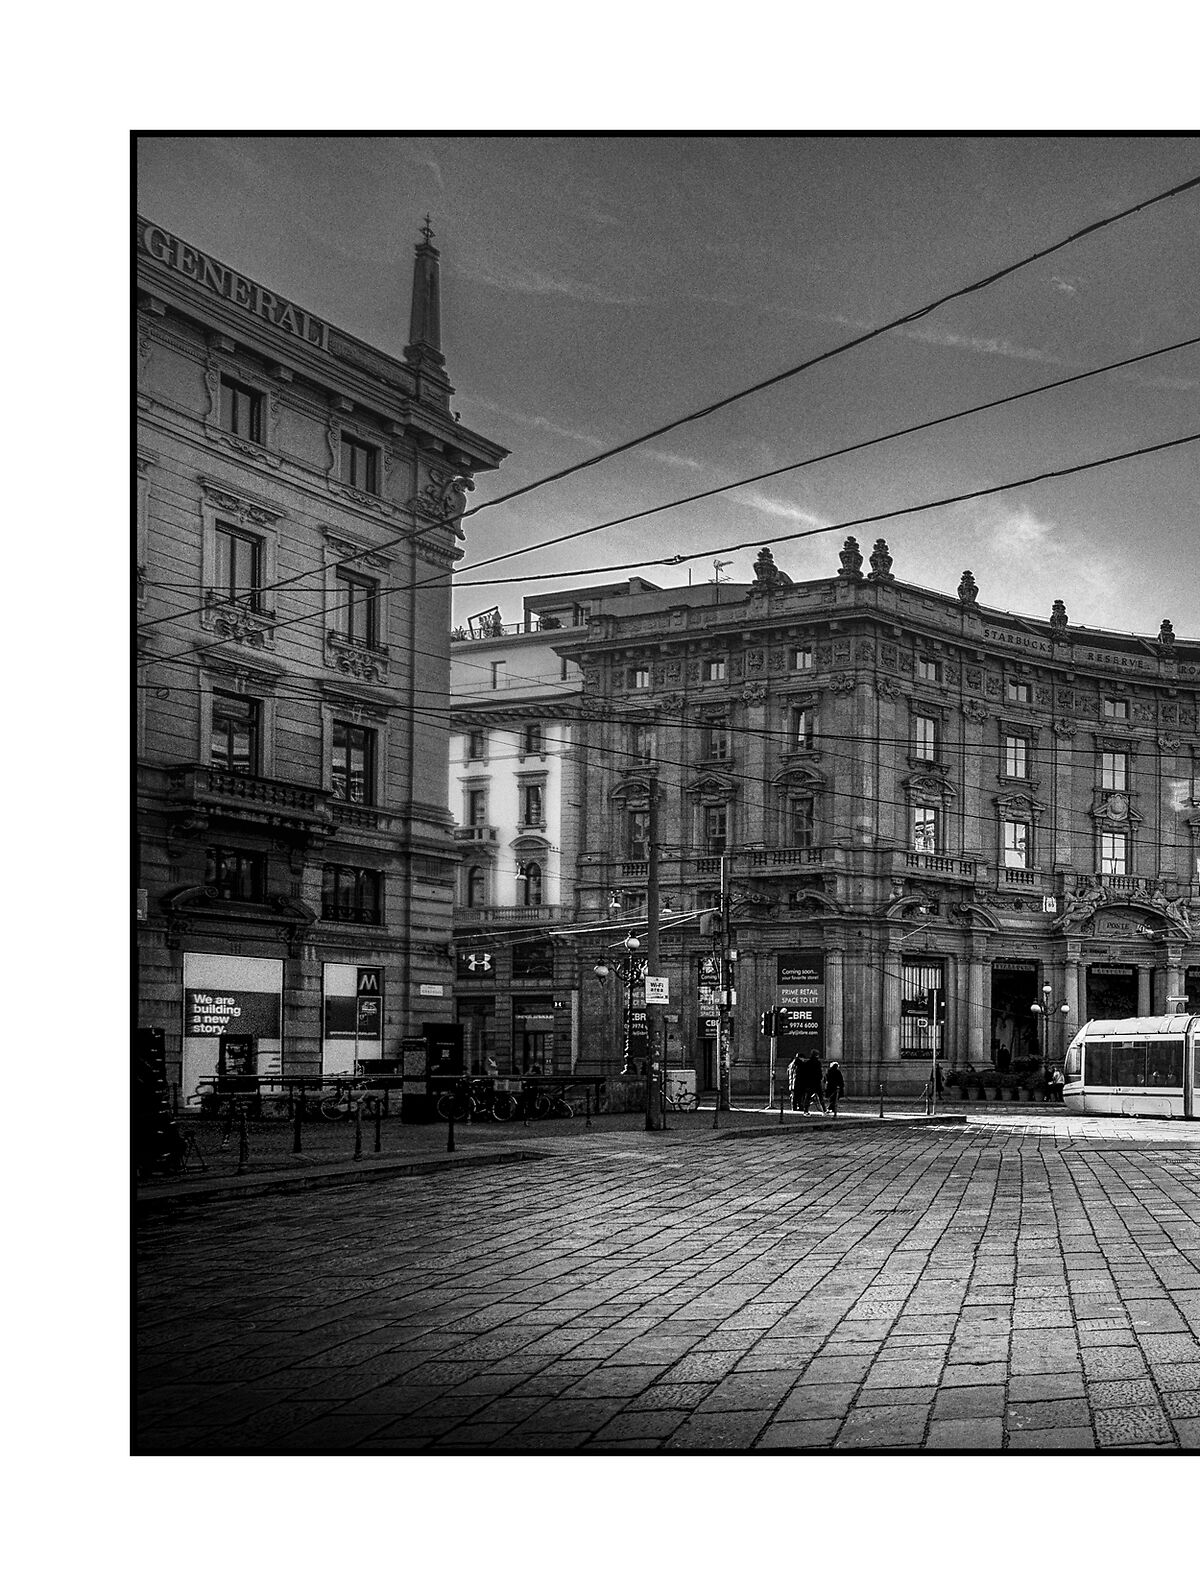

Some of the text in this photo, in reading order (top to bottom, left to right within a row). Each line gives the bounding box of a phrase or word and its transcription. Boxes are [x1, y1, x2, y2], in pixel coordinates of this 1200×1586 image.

[144, 225, 334, 353] GENERALI
[984, 629, 1053, 652] STARBUCKS
[1087, 652, 1144, 668] RESERVE
[358, 974, 378, 990] M
[781, 988, 819, 996] PRIME RETAIL
[193, 994, 235, 1005] We are
[193, 1003, 241, 1017] building
[193, 1015, 230, 1024] a new
[193, 1023, 227, 1035] story.
